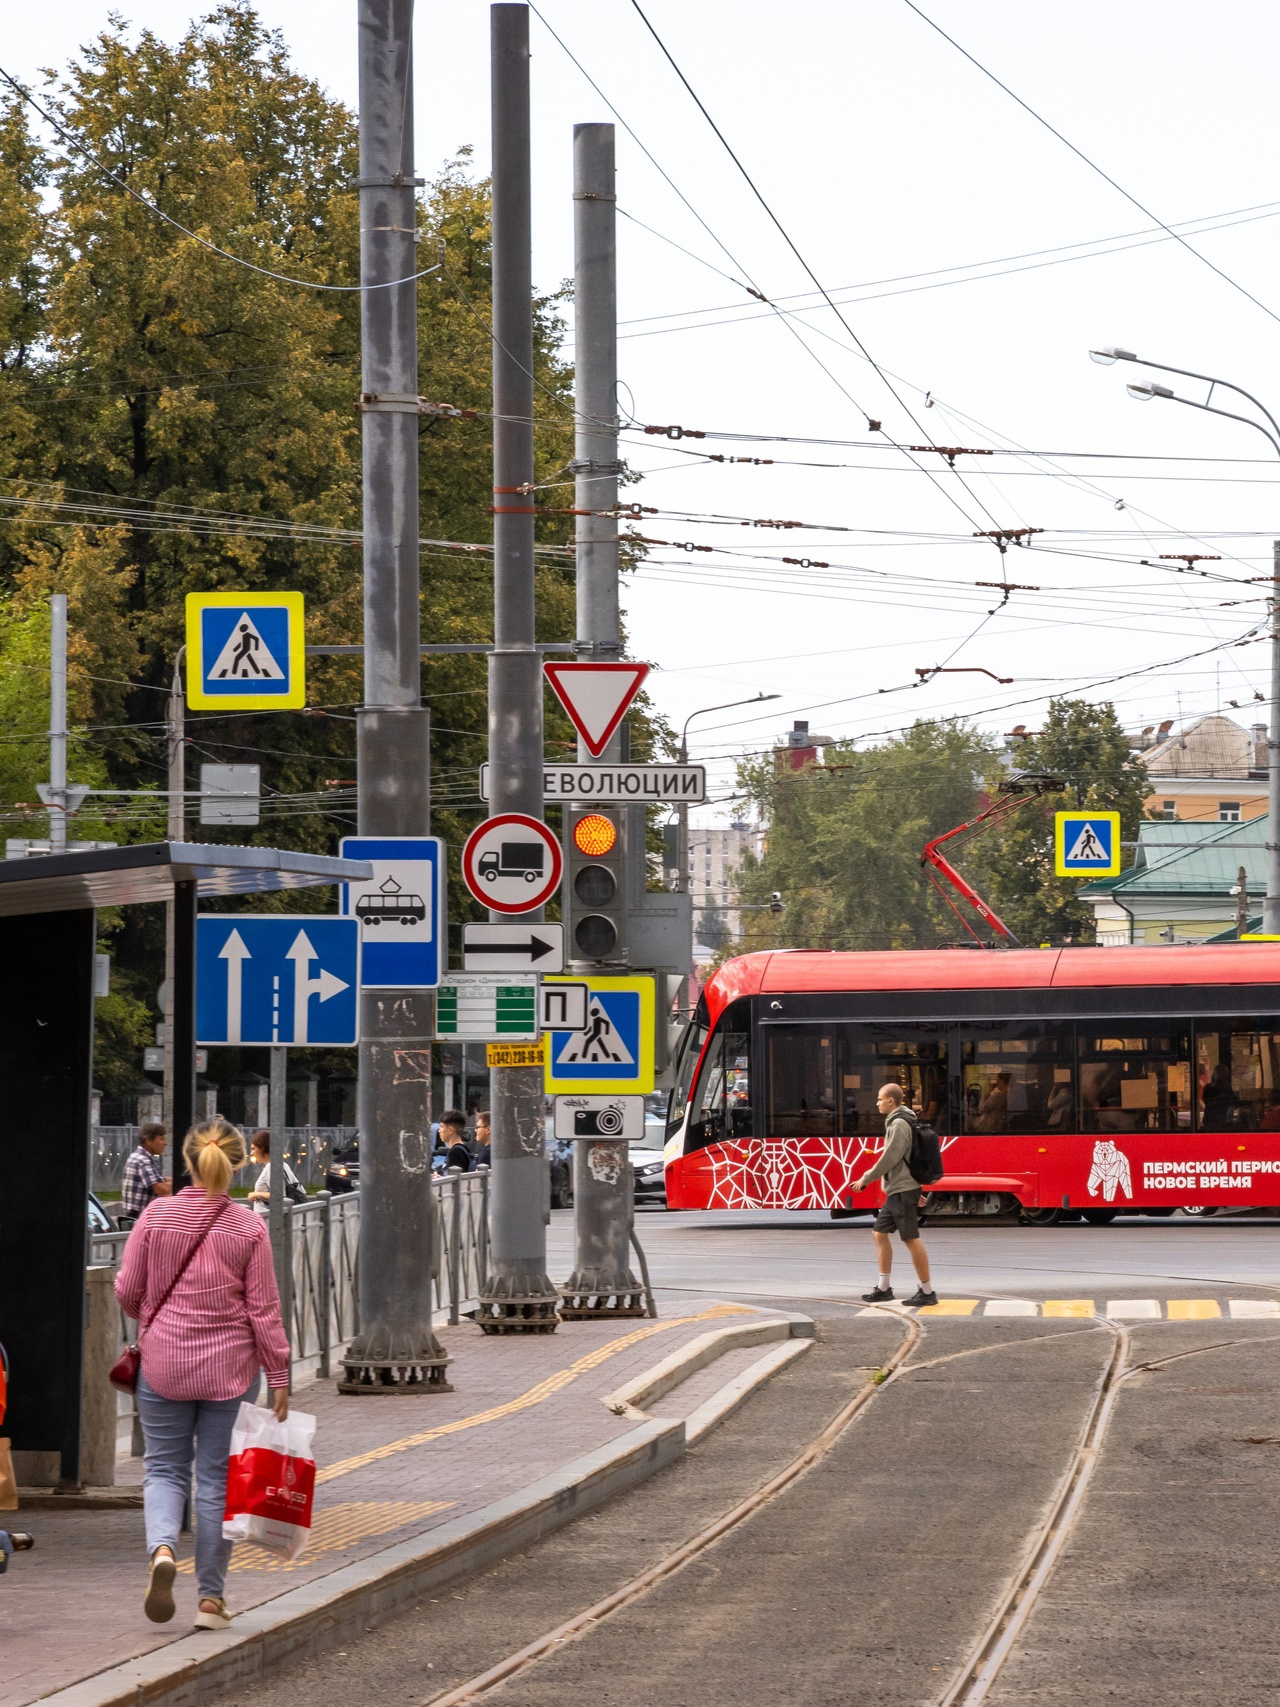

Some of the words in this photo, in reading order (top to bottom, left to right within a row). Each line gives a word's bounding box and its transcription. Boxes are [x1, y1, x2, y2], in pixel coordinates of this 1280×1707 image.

[543, 772, 698, 798] ЕВОЛЮЦИИ
[545, 991, 567, 1022] П
[1143, 1158, 1228, 1174] ПЕРМСКИЙ
[1143, 1176, 1196, 1189] НОВОЕ
[1200, 1176, 1252, 1188] ВРЕМЯ
